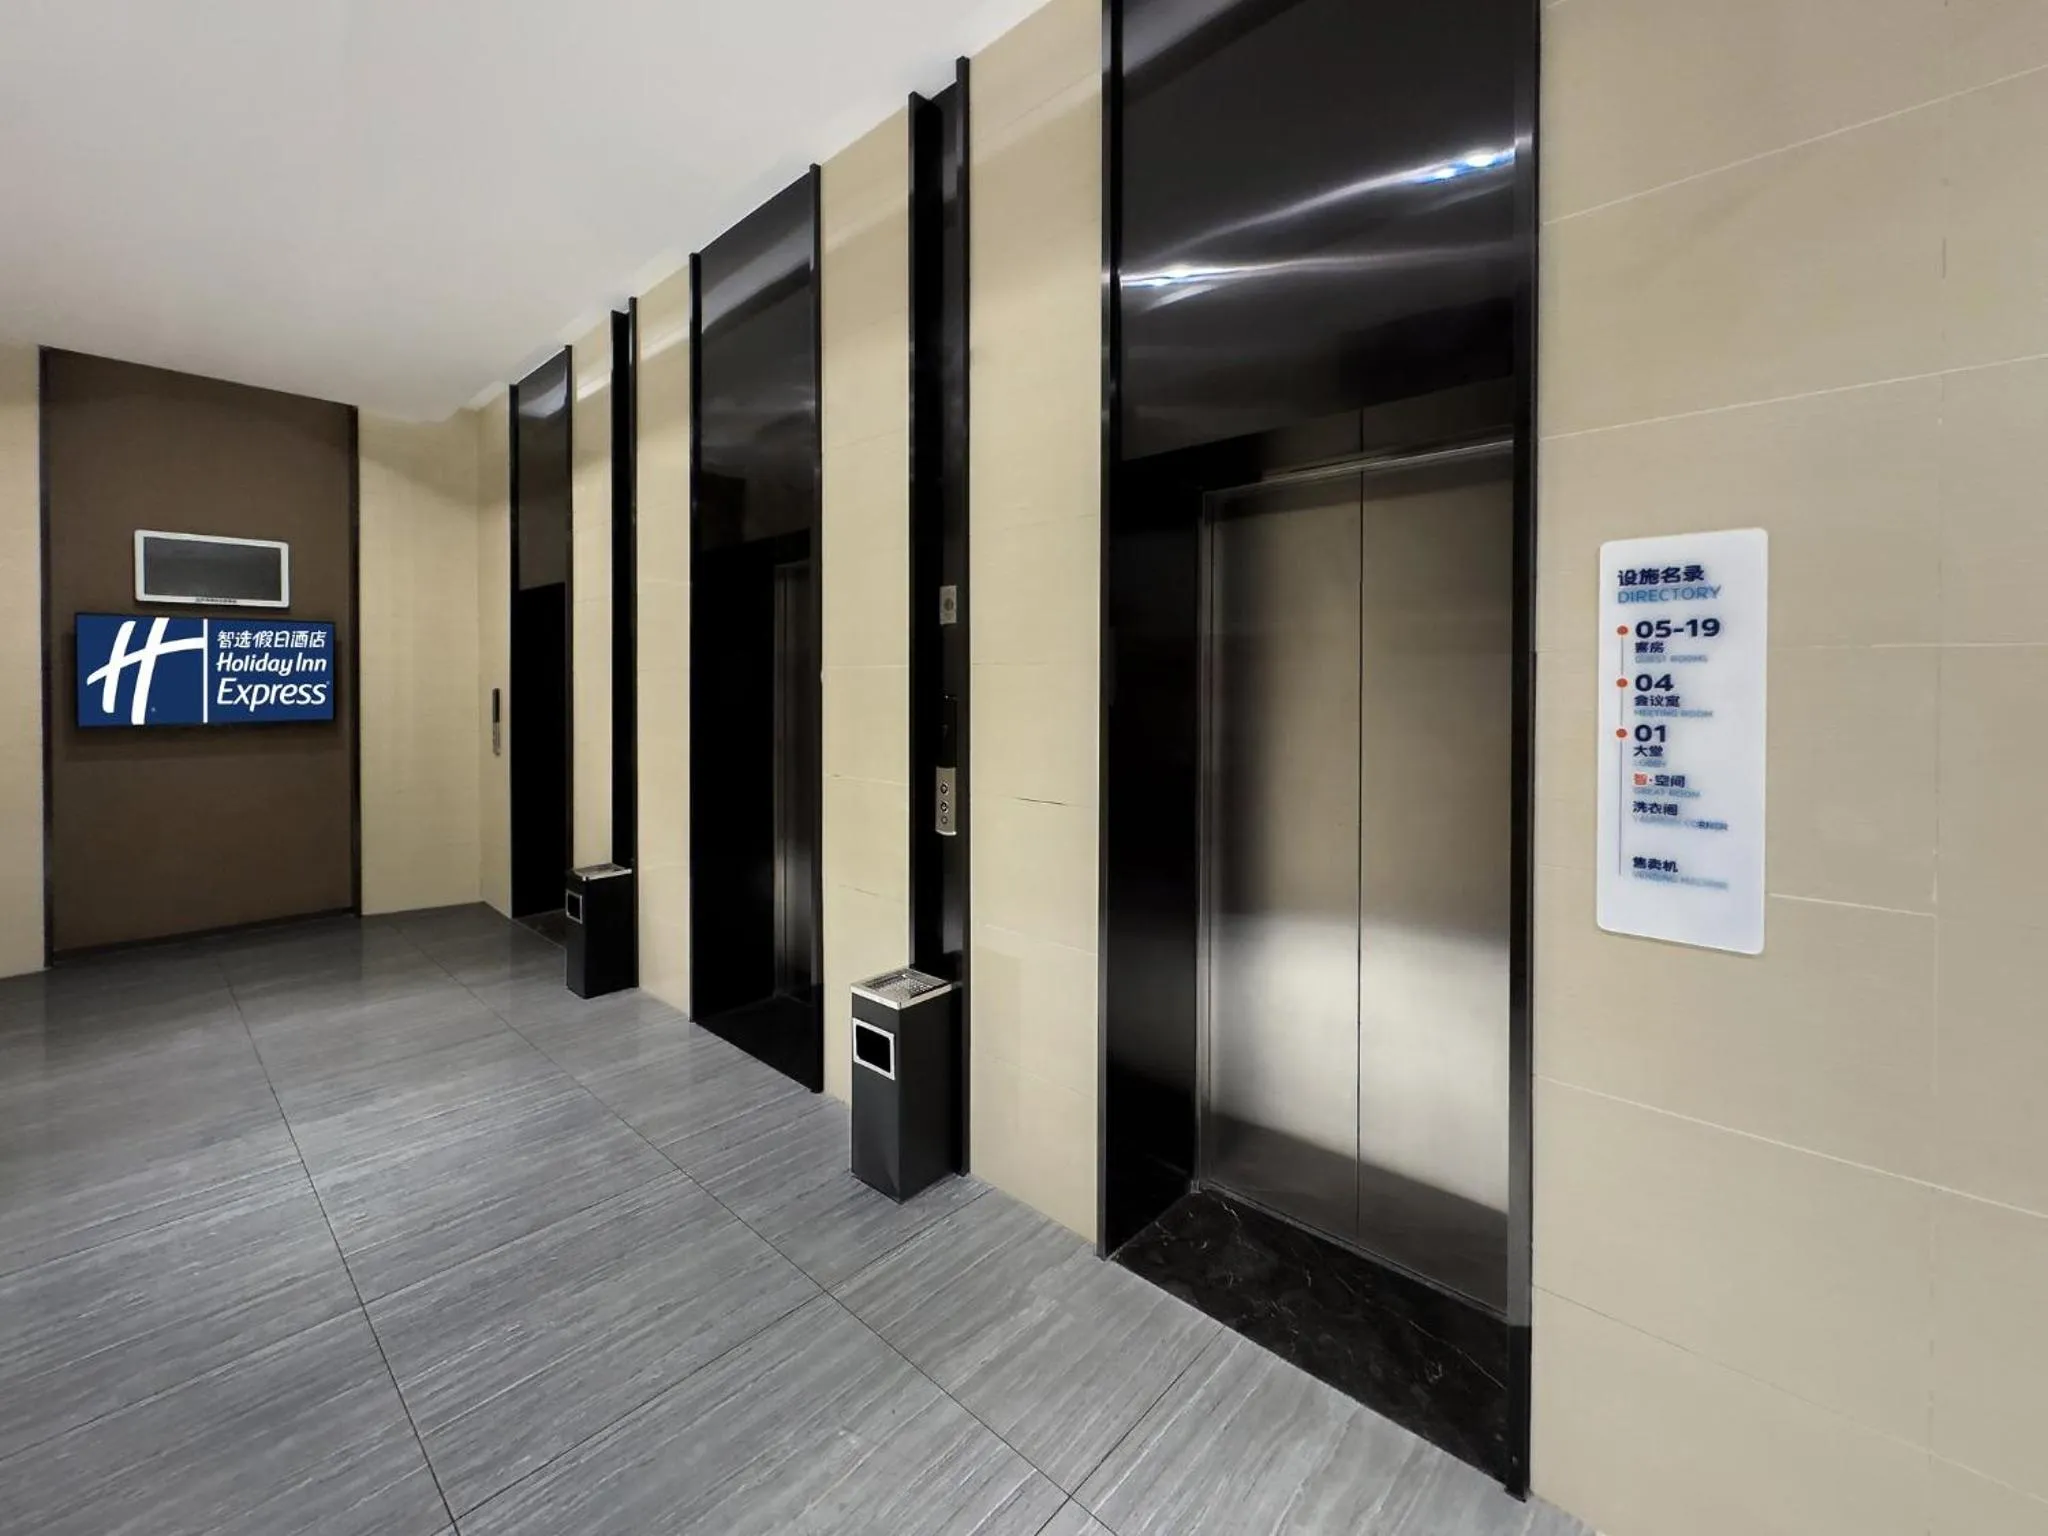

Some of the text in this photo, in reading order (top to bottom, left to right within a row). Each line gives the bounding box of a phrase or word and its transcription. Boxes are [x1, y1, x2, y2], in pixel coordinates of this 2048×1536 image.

[1617, 565, 1704, 586] 设施名录
[1617, 585, 1721, 604] DIRECTORY
[1635, 618, 1721, 639] 05-19
[218, 630, 327, 648] 智选假日酒店
[216, 652, 327, 676] Holiday Inn
[1635, 674, 1674, 691] 04
[217, 677, 327, 712] Express
[1634, 695, 1680, 707] 会议室
[1634, 724, 1667, 742] 01
[1633, 745, 1663, 757] 大堂
